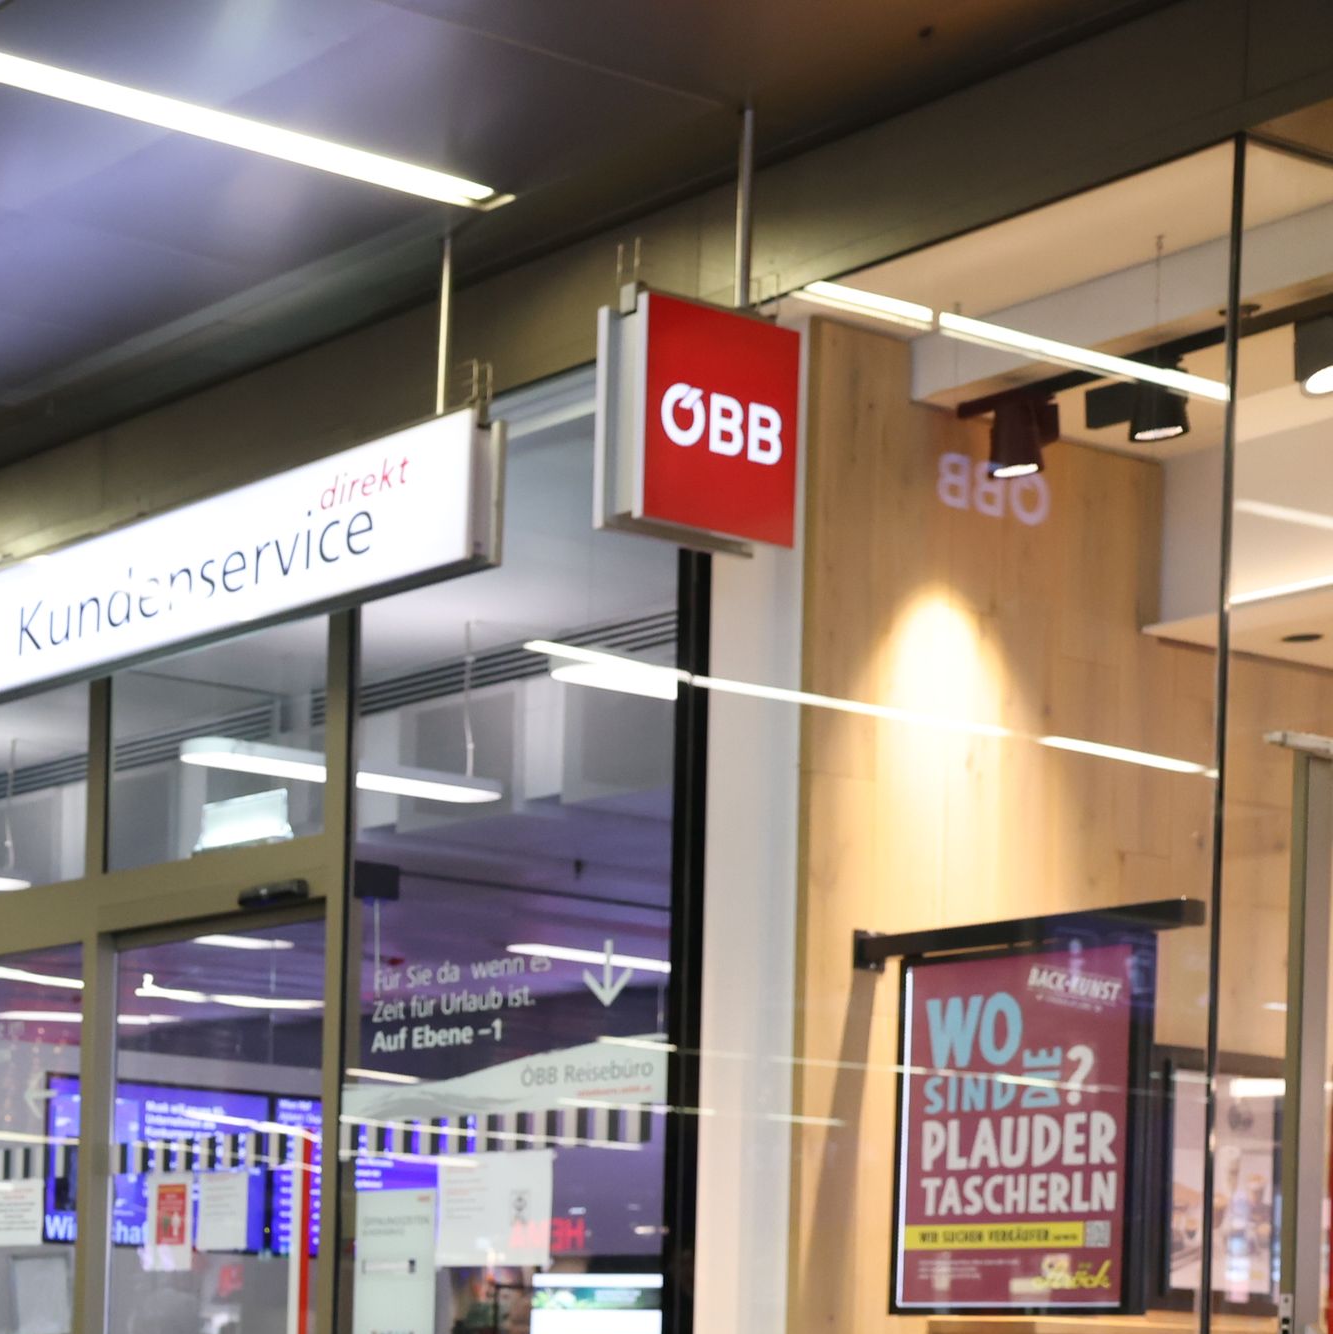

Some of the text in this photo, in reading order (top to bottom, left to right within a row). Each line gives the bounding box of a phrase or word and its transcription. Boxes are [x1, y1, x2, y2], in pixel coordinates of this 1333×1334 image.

[660, 382, 783, 466] ÖBB
[320, 455, 409, 511] direkt
[17, 508, 373, 657] Kundenservice
[374, 969, 401, 992] Für
[407, 966, 432, 988] Sie
[471, 956, 525, 979] wenn
[530, 955, 552, 973] es
[372, 985, 535, 1023] Zeit für Urlaub ist.
[926, 991, 1023, 1069] WO
[371, 1026, 408, 1053] Auf
[412, 1023, 474, 1049] Ebene
[520, 1059, 654, 1087] ÖBB Reisebüro
[923, 1073, 1017, 1115] SIND
[1021, 1046, 1063, 1109] DIE
[921, 1110, 1117, 1172] PLAUDER
[920, 1171, 1117, 1217] TASCHERLN
